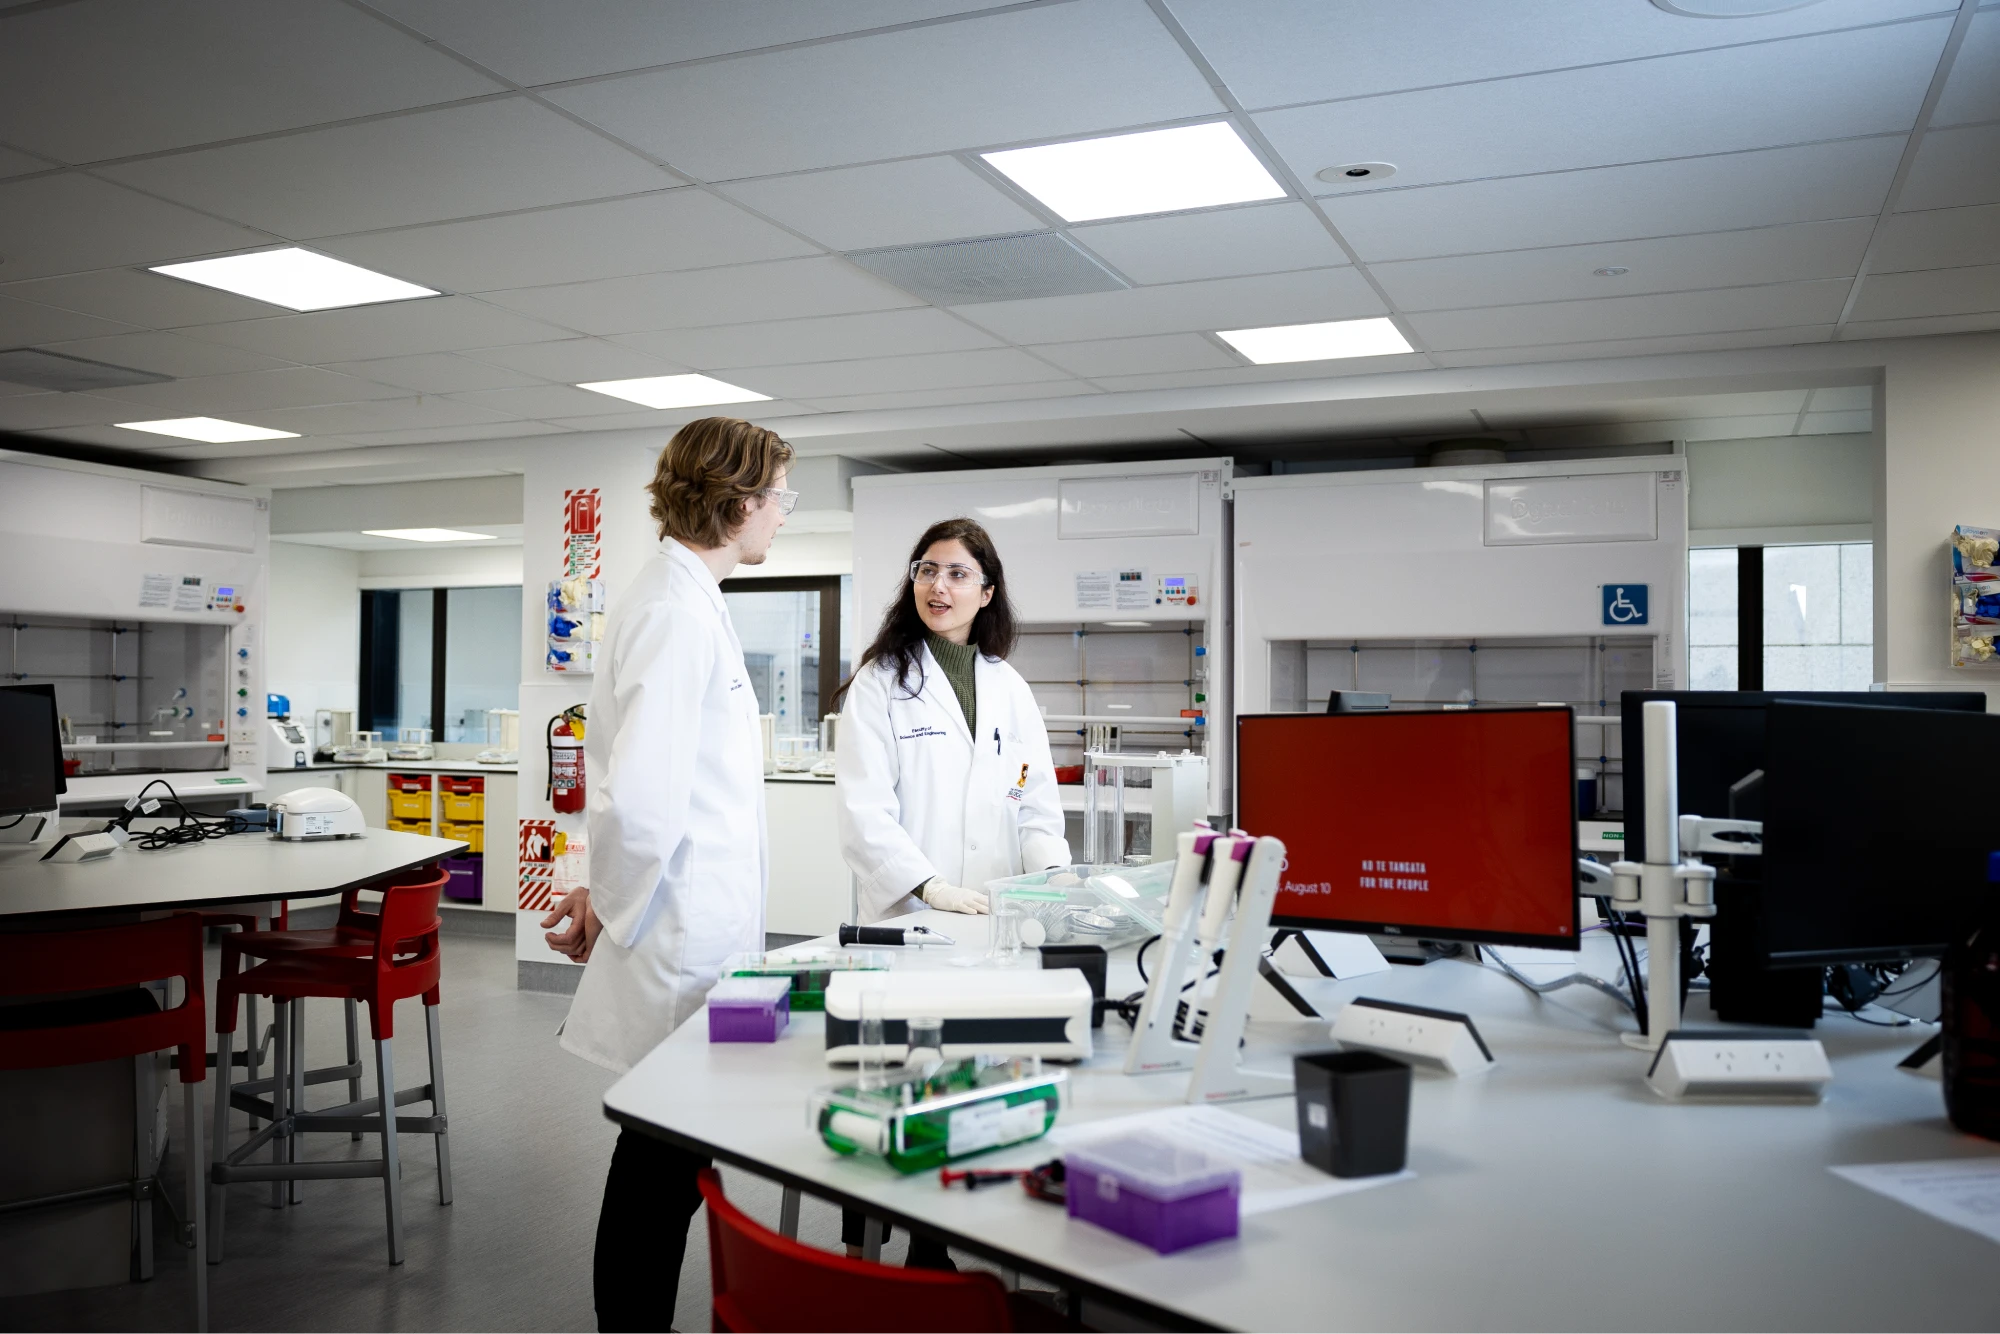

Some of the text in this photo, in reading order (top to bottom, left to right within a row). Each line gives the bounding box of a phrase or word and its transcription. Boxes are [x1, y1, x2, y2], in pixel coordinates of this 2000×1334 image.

[1376, 861, 1386, 872] TE
[1285, 881, 1318, 896] August
[1320, 882, 1331, 894] 10
[1360, 877, 1429, 891] FOR THE PEOPLE
